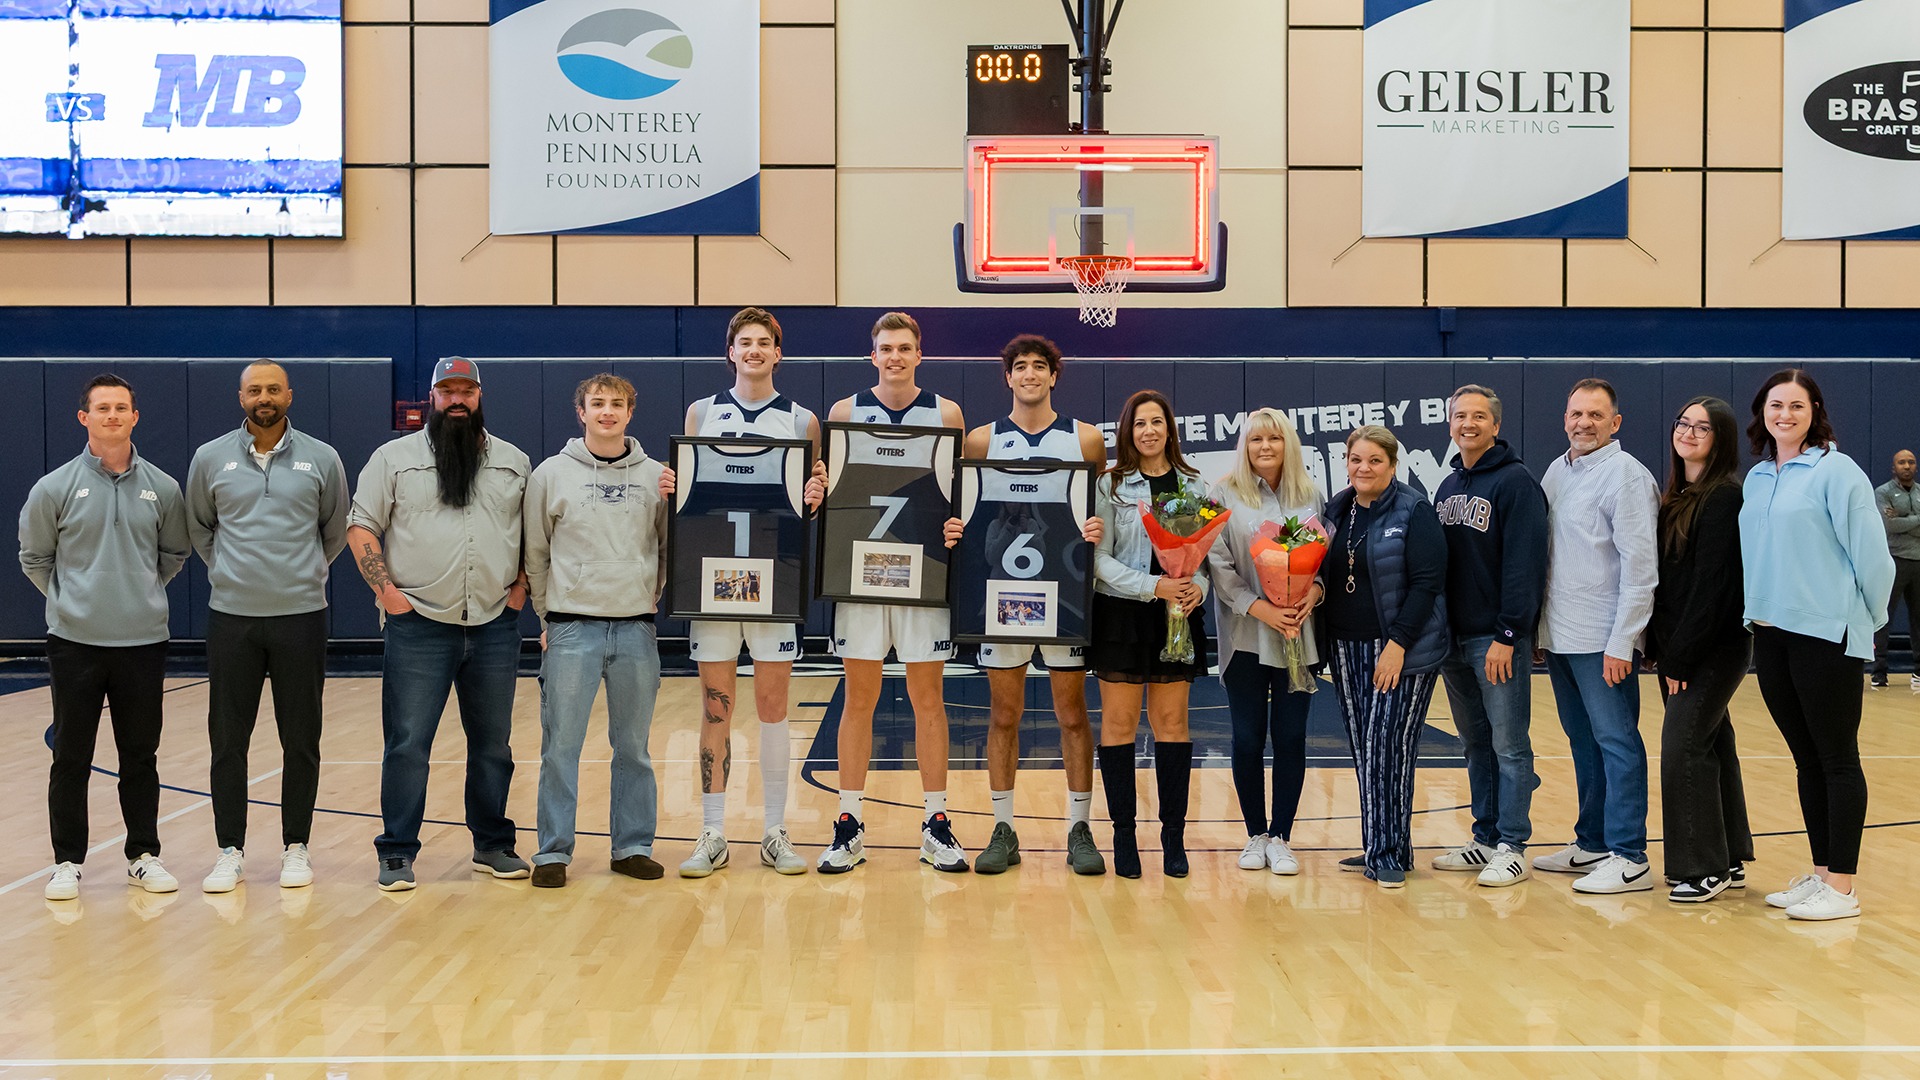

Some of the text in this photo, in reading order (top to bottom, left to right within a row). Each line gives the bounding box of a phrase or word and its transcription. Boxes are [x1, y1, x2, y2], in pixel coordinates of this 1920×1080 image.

[976, 53, 1041, 82] 00.0
[142, 53, 306, 128] MB
[1377, 70, 1615, 114] GEISLER
[1853, 83, 1884, 95] THE
[55, 96, 93, 121] VS
[546, 112, 702, 133] MONTEREY
[1432, 120, 1560, 134] MARKETING
[1865, 125, 1908, 135] CRAFT
[546, 143, 703, 164] PENINSULA
[546, 173, 701, 189] FOUNDATION
[876, 446, 906, 458] OTTERS
[292, 461, 313, 472] MB
[725, 464, 755, 475] OTTERS
[1009, 483, 1039, 493] OTTERS
[867, 495, 910, 539] 7
[727, 511, 750, 558] 1
[1001, 533, 1045, 579] 6
[778, 641, 795, 652] MB
[933, 641, 951, 652] MB
